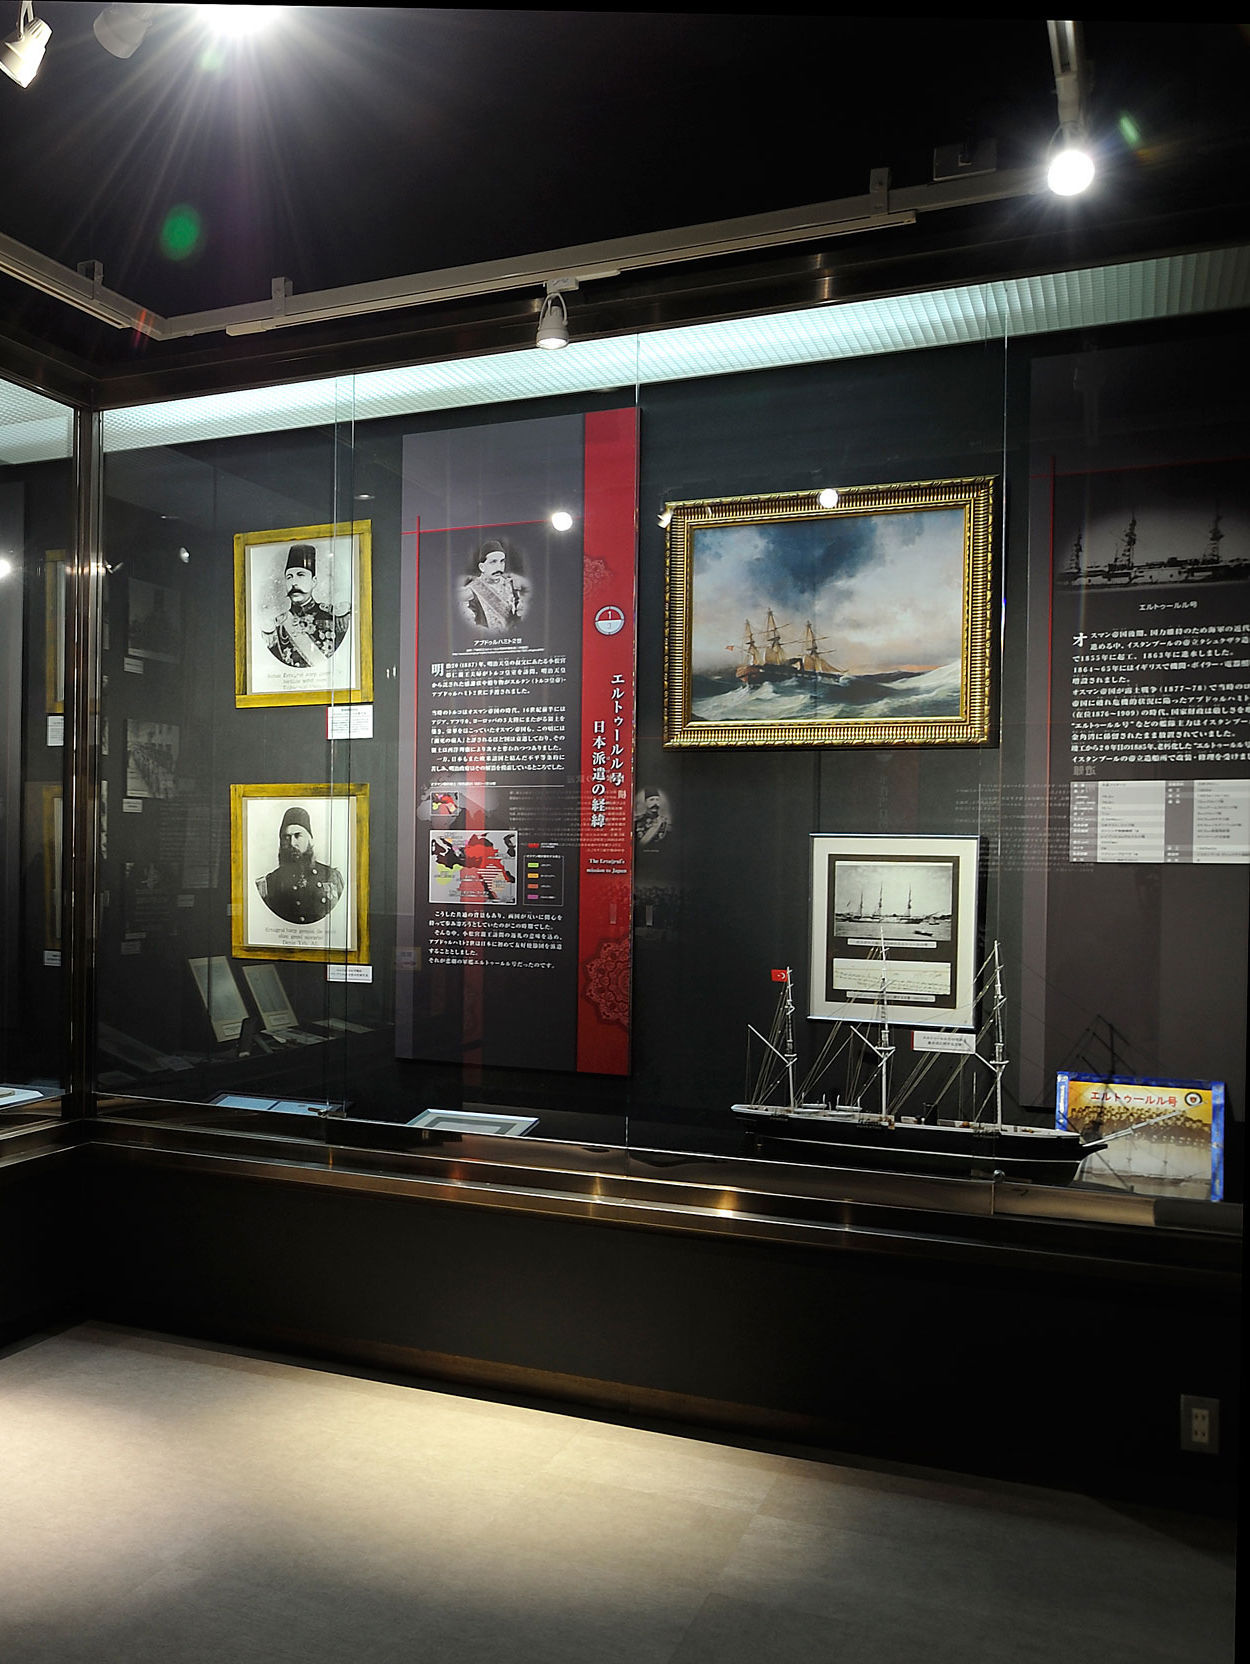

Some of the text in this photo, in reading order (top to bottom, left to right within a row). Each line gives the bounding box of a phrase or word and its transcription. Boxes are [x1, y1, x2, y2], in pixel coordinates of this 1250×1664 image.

[1139, 601, 1198, 612] エルトゥールル号
[1072, 632, 1088, 647] オ
[431, 663, 444, 677] 明
[610, 674, 625, 787] エルトゥールル号
[591, 720, 607, 828] 日本派遣の経緯
[1090, 1091, 1177, 1107] エルトゥールル号
